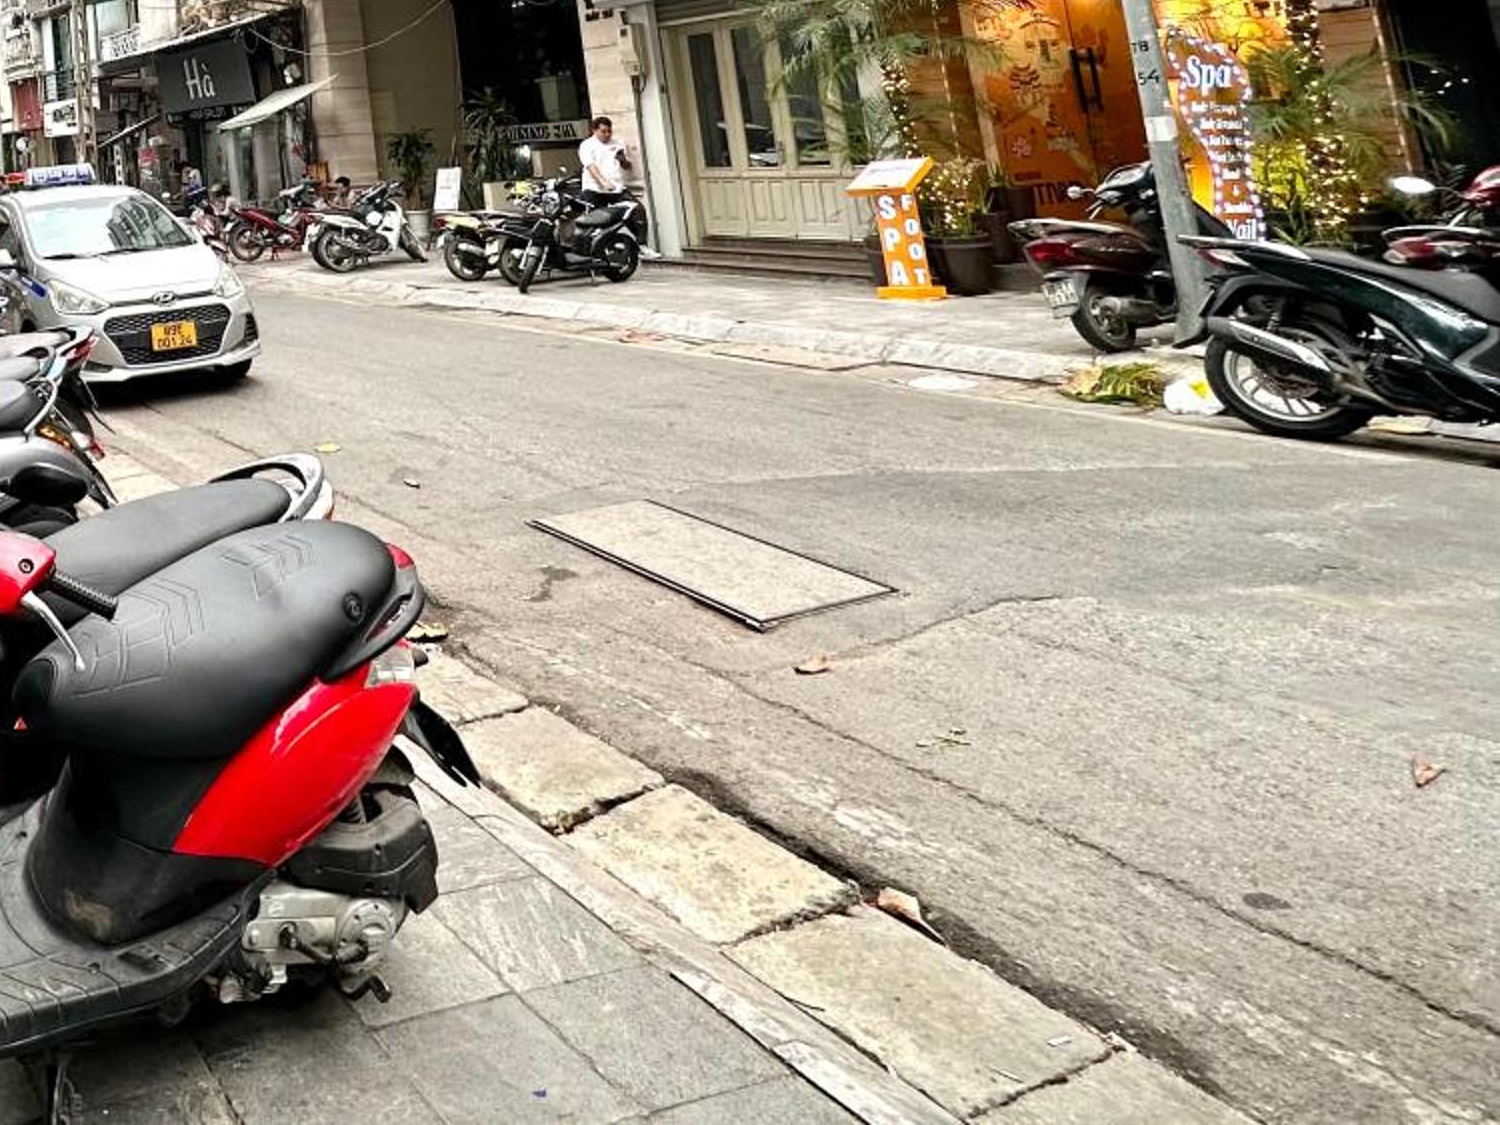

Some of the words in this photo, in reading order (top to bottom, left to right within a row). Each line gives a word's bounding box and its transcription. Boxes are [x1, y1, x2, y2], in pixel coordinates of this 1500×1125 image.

[183, 58, 215, 100] Hà
[1186, 55, 1230, 95] Spa
[878, 194, 910, 286] SPA
[900, 193, 927, 284] FOOT
